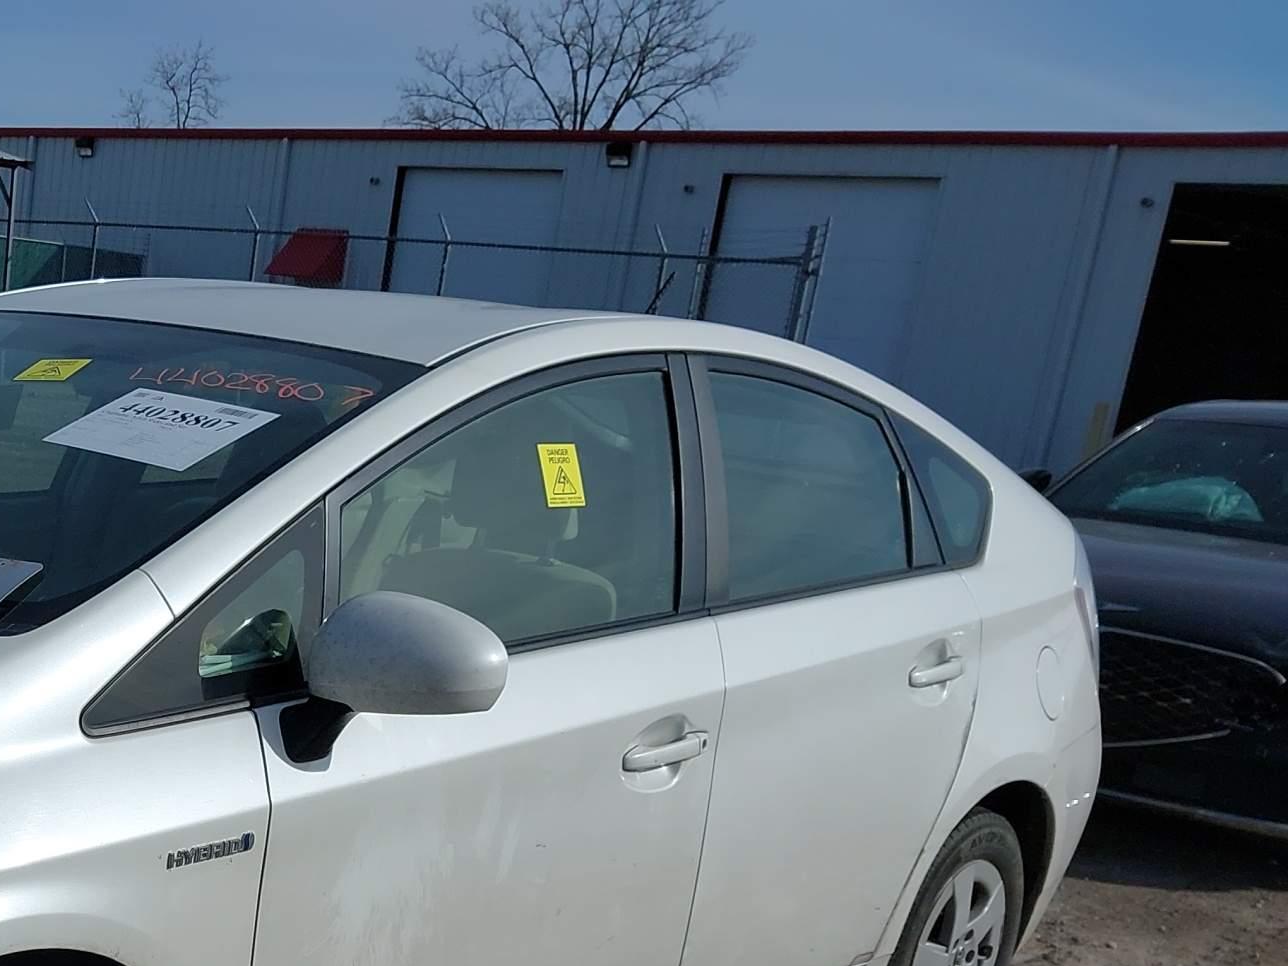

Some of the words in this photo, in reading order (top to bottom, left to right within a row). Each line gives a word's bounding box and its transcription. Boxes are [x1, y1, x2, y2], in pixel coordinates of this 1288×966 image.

[119, 402, 240, 432] 44028807
[546, 448, 569, 456] DANGER
[166, 838, 244, 870] HYBRID
